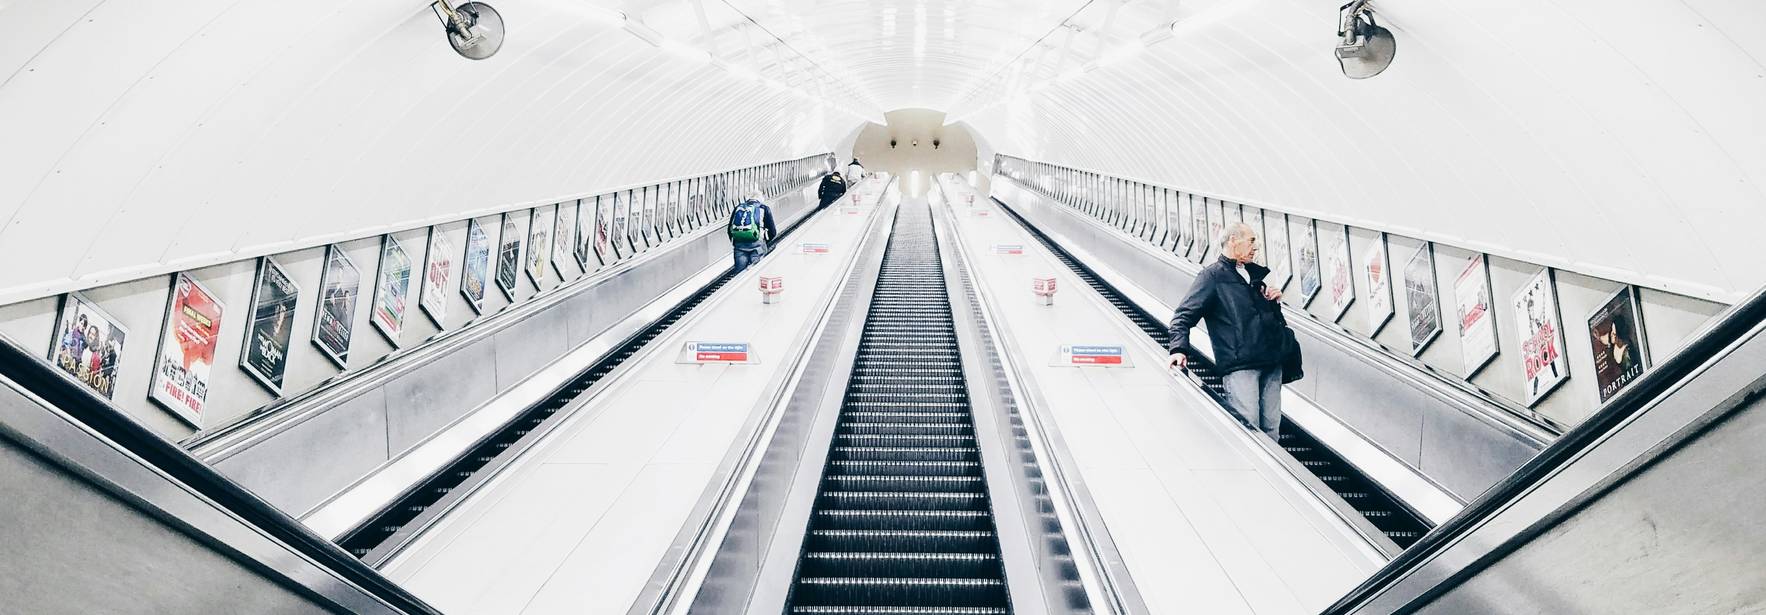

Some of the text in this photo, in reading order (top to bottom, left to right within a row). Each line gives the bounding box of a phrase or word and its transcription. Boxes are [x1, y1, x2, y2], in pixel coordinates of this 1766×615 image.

[60, 353, 110, 395] PASSION
[1525, 339, 1559, 382] ROCK
[165, 381, 184, 402] FIRE!
[1602, 363, 1640, 397] PORTRAIT
